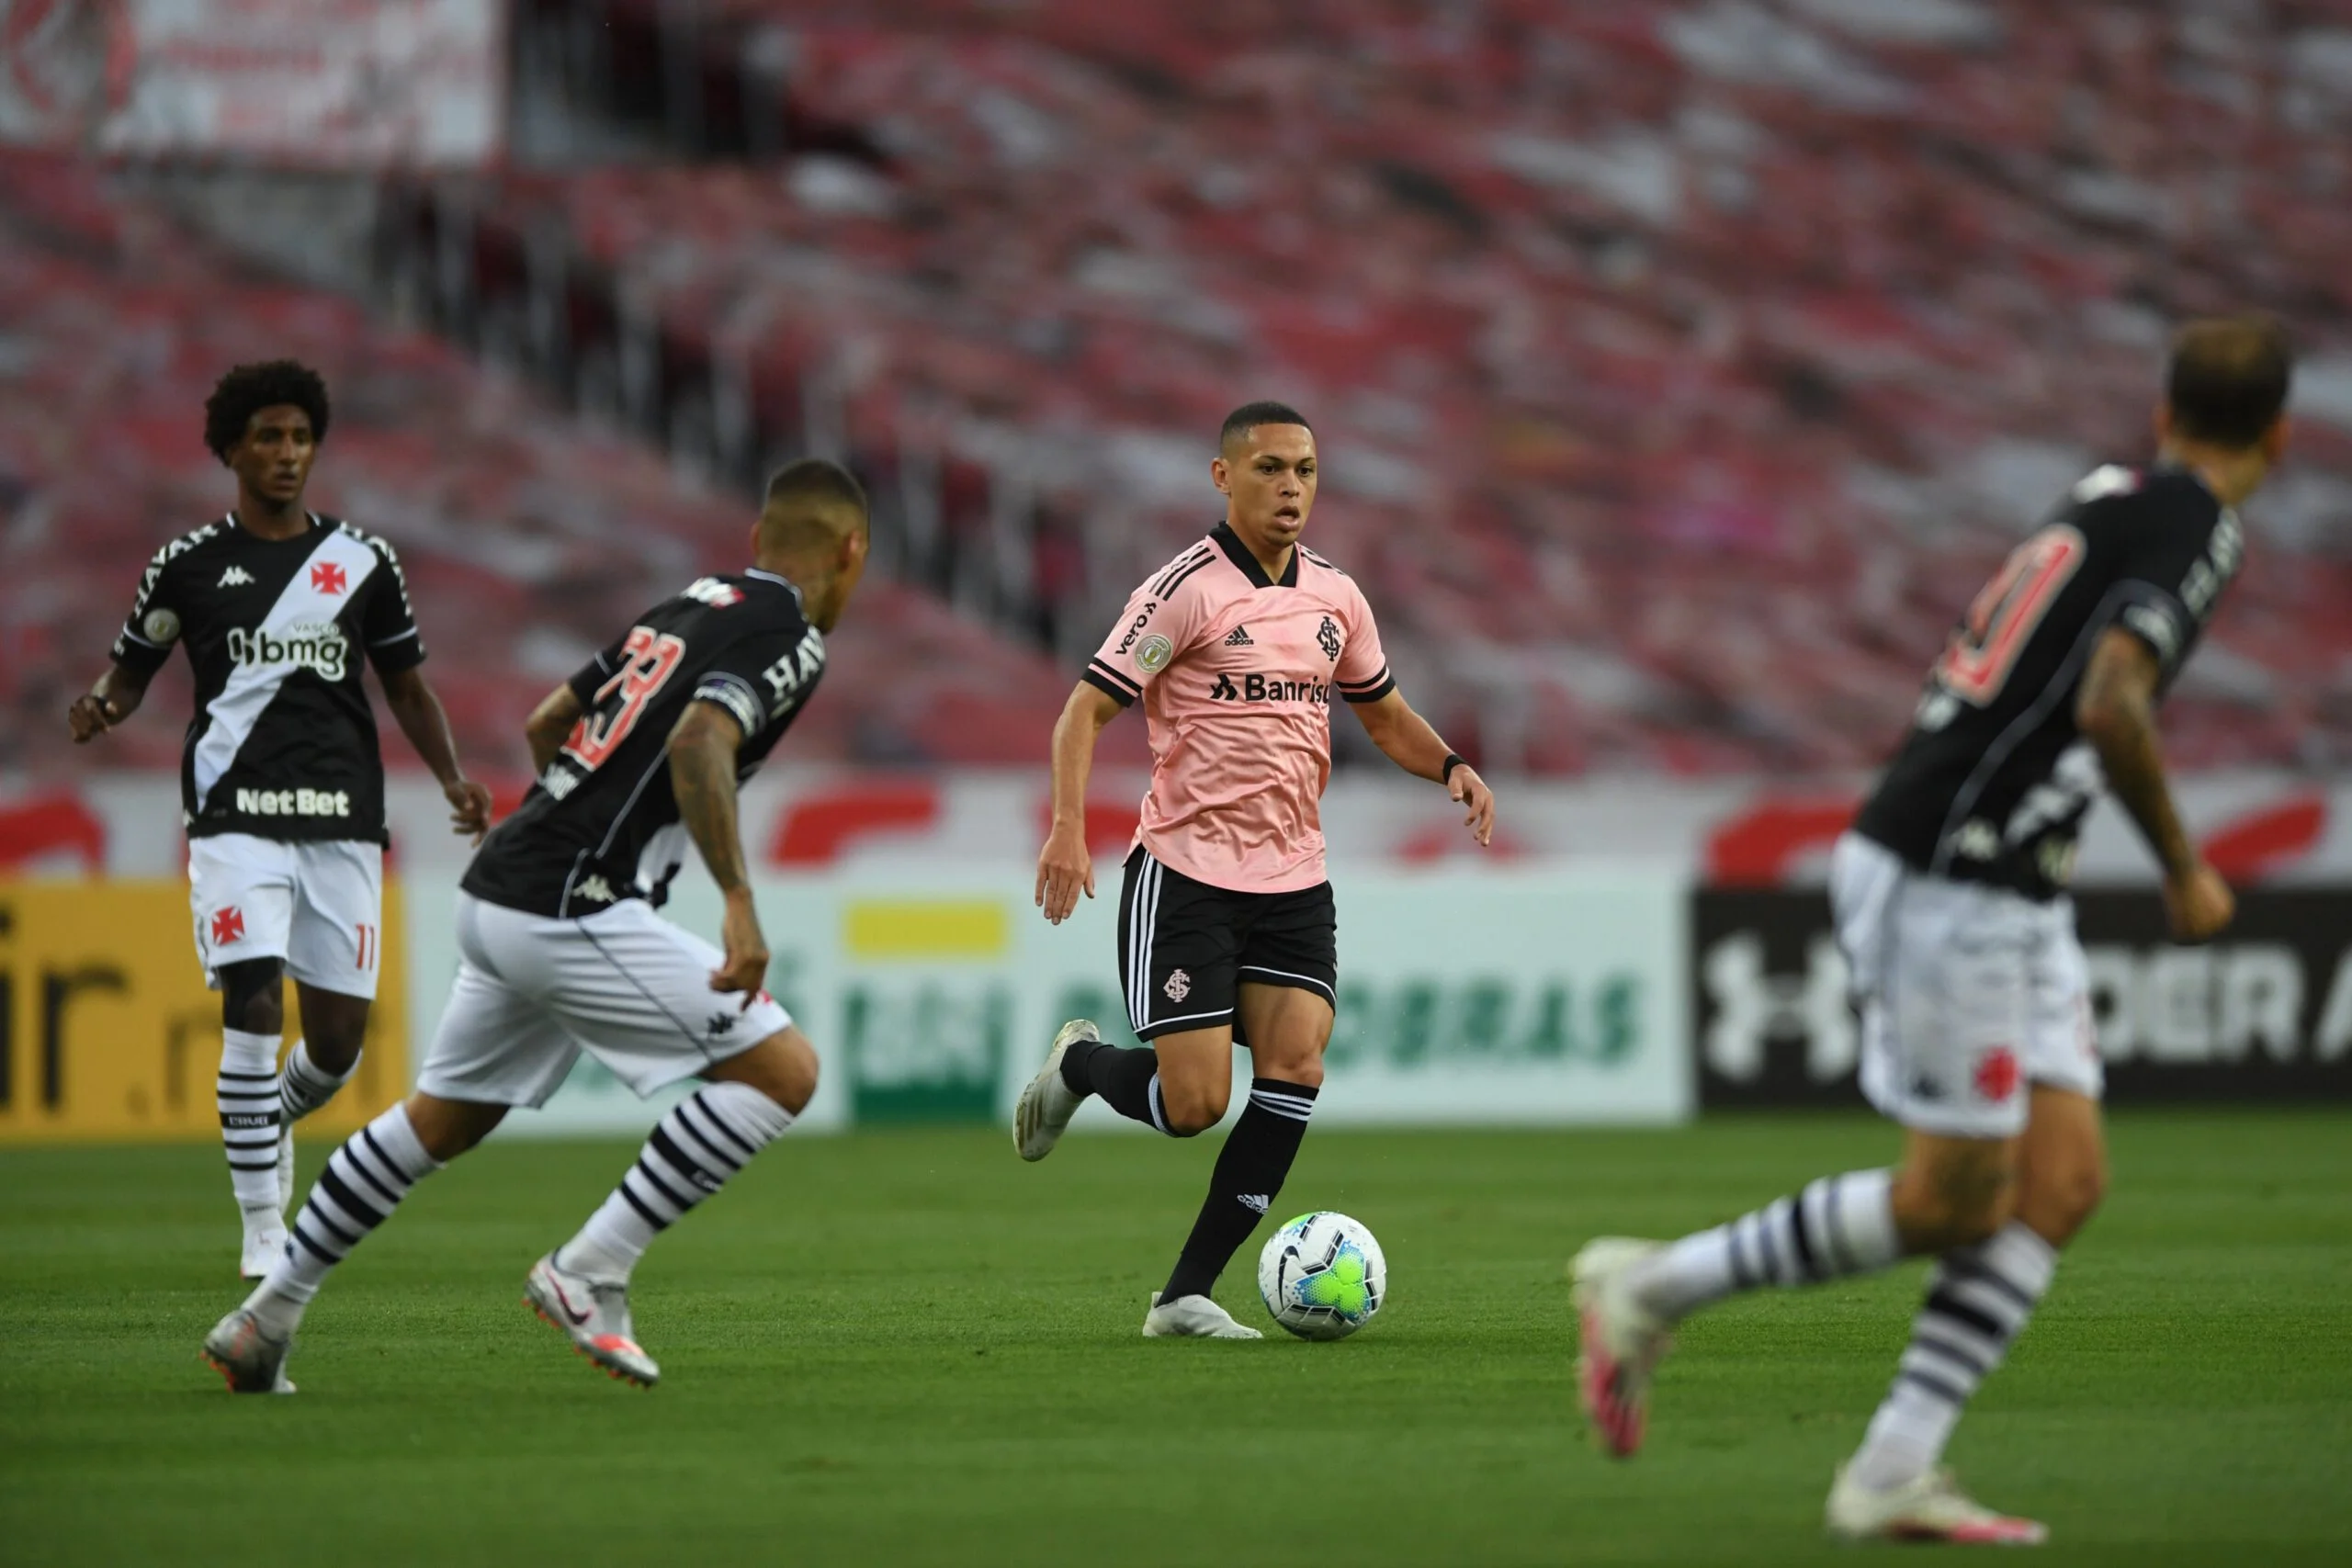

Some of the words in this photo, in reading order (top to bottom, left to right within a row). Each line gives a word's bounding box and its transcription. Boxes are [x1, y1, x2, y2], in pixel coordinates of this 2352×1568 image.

[258, 630, 345, 676] bmg
[1114, 614, 1148, 656] vero
[1224, 637, 1255, 647] adidas
[236, 788, 351, 817] NetBet
[355, 922, 375, 972] 11
